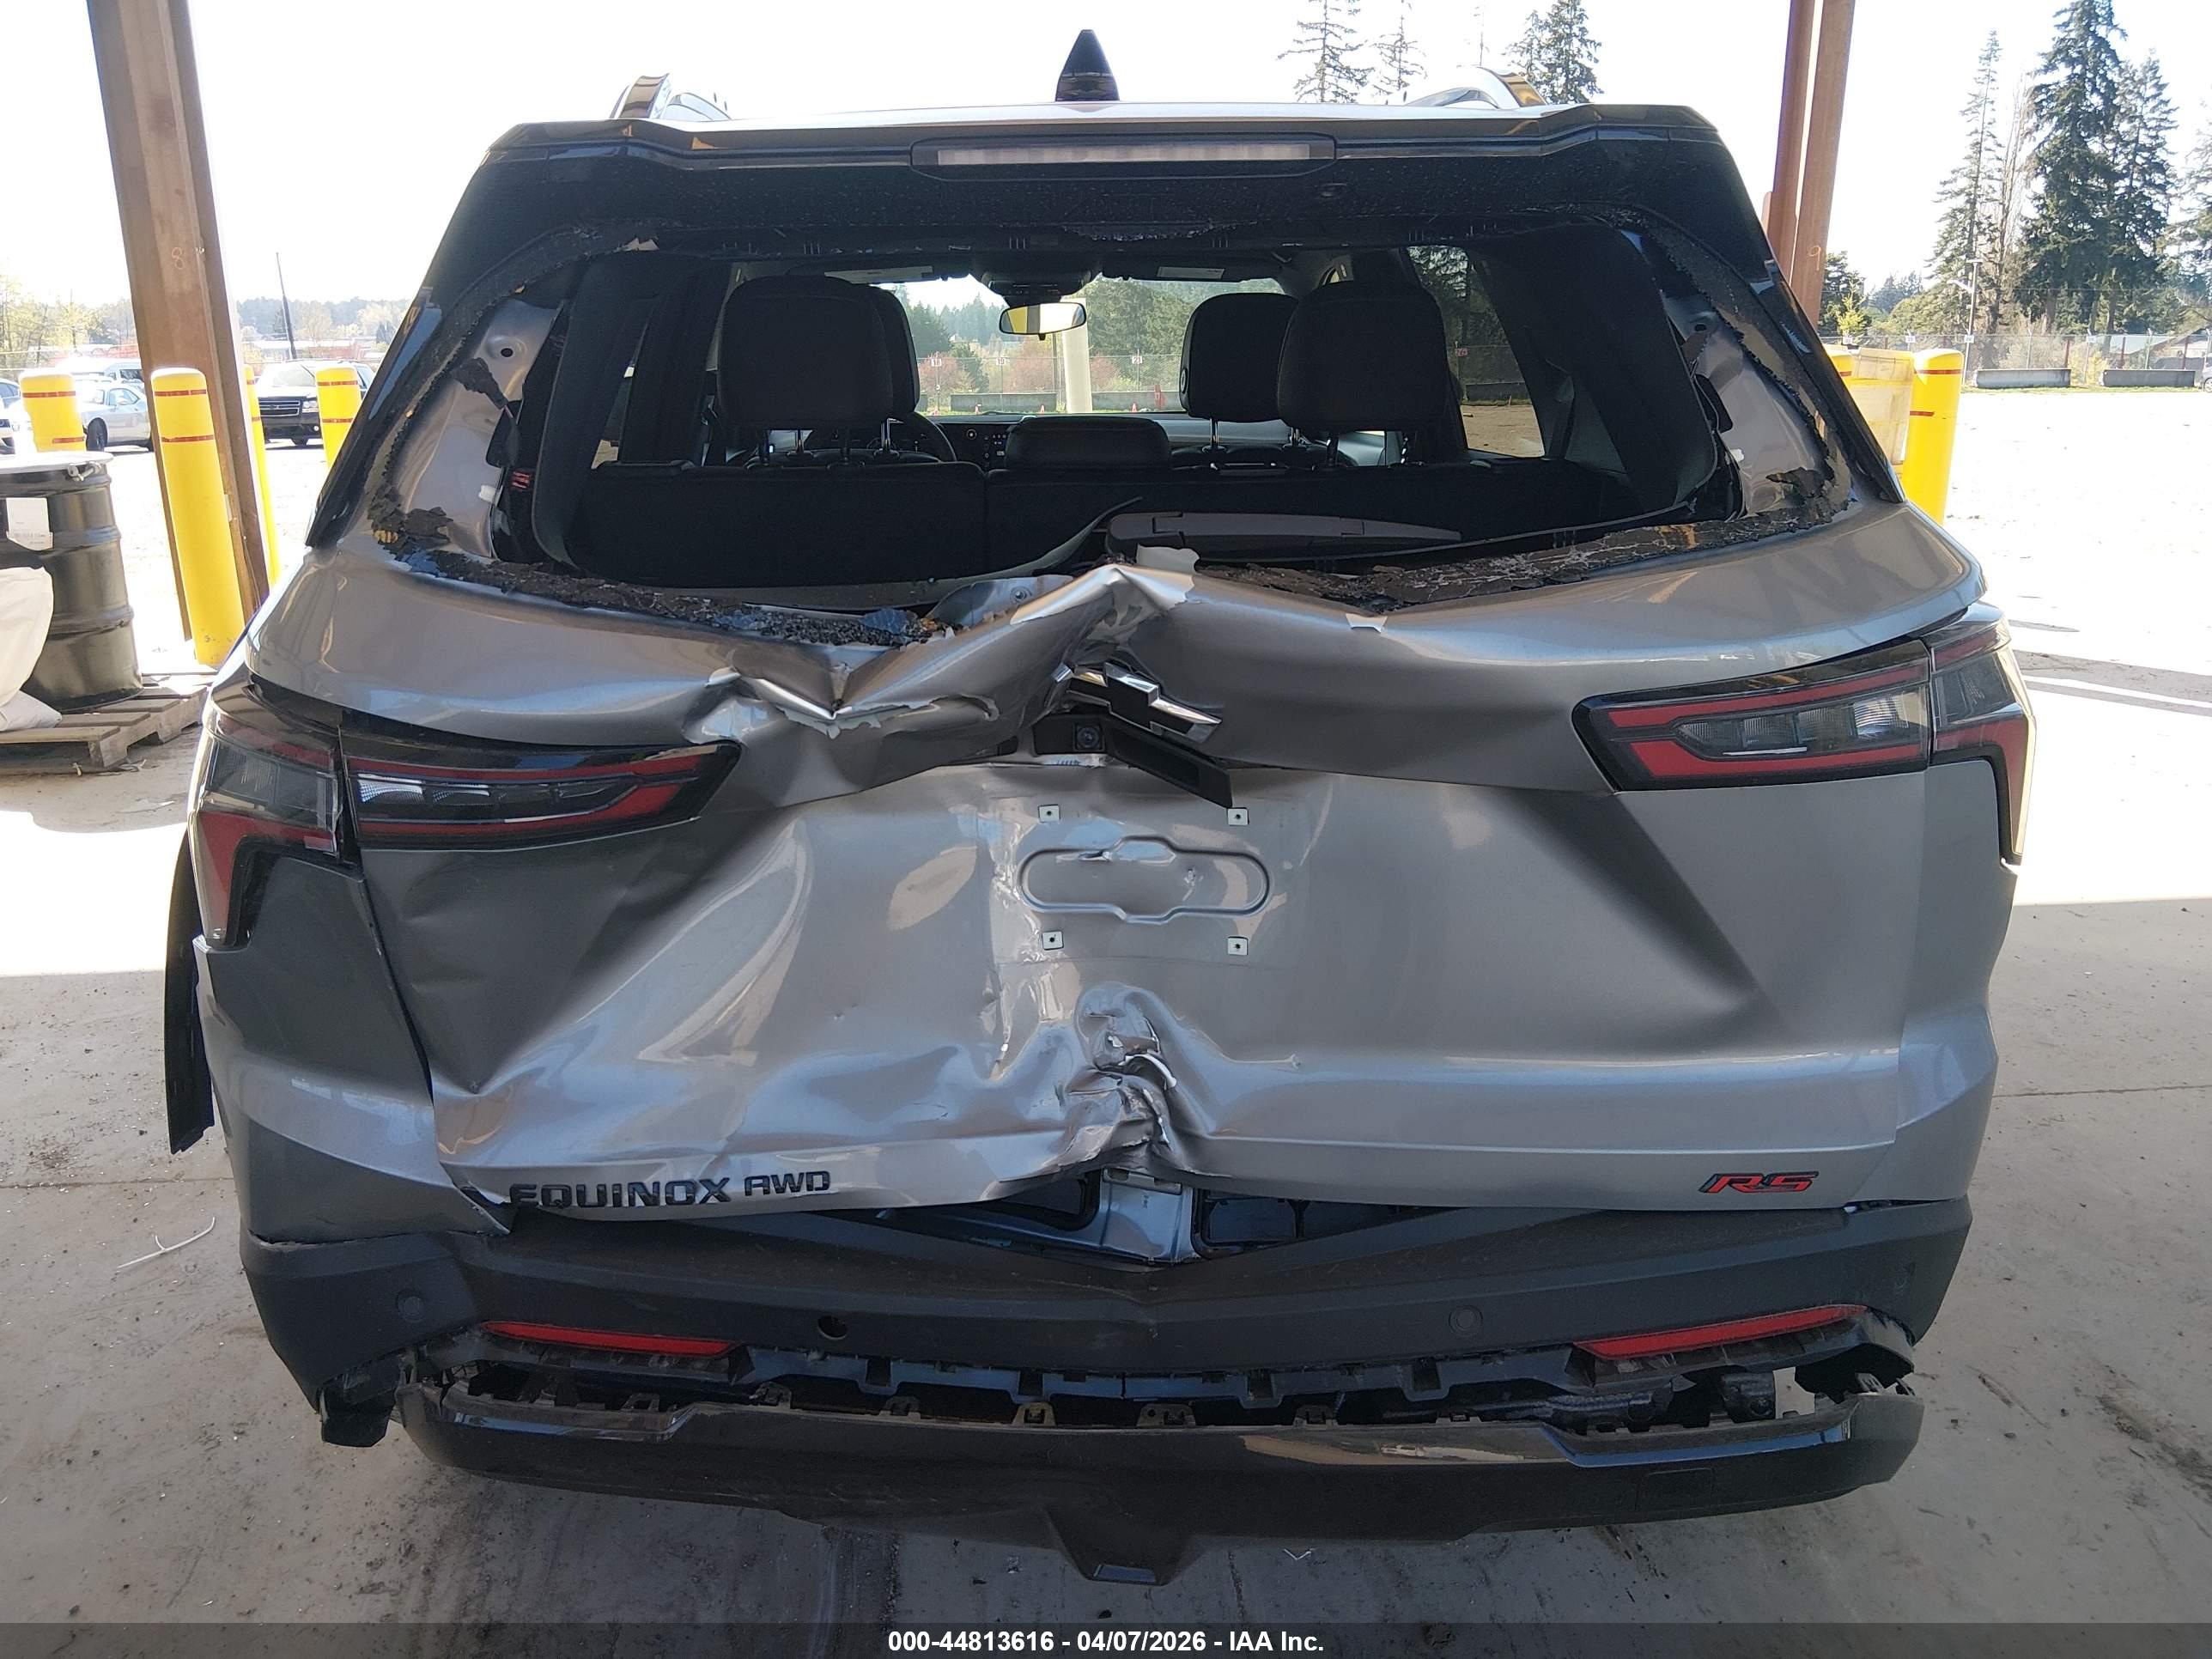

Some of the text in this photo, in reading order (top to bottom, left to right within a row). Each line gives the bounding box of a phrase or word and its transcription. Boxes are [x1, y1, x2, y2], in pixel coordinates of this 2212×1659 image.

[172, 246, 185, 270] 8
[1807, 245, 1821, 270] 9
[509, 1170, 830, 1208] EQUINOX AWD
[1698, 1170, 1819, 1193] RS
